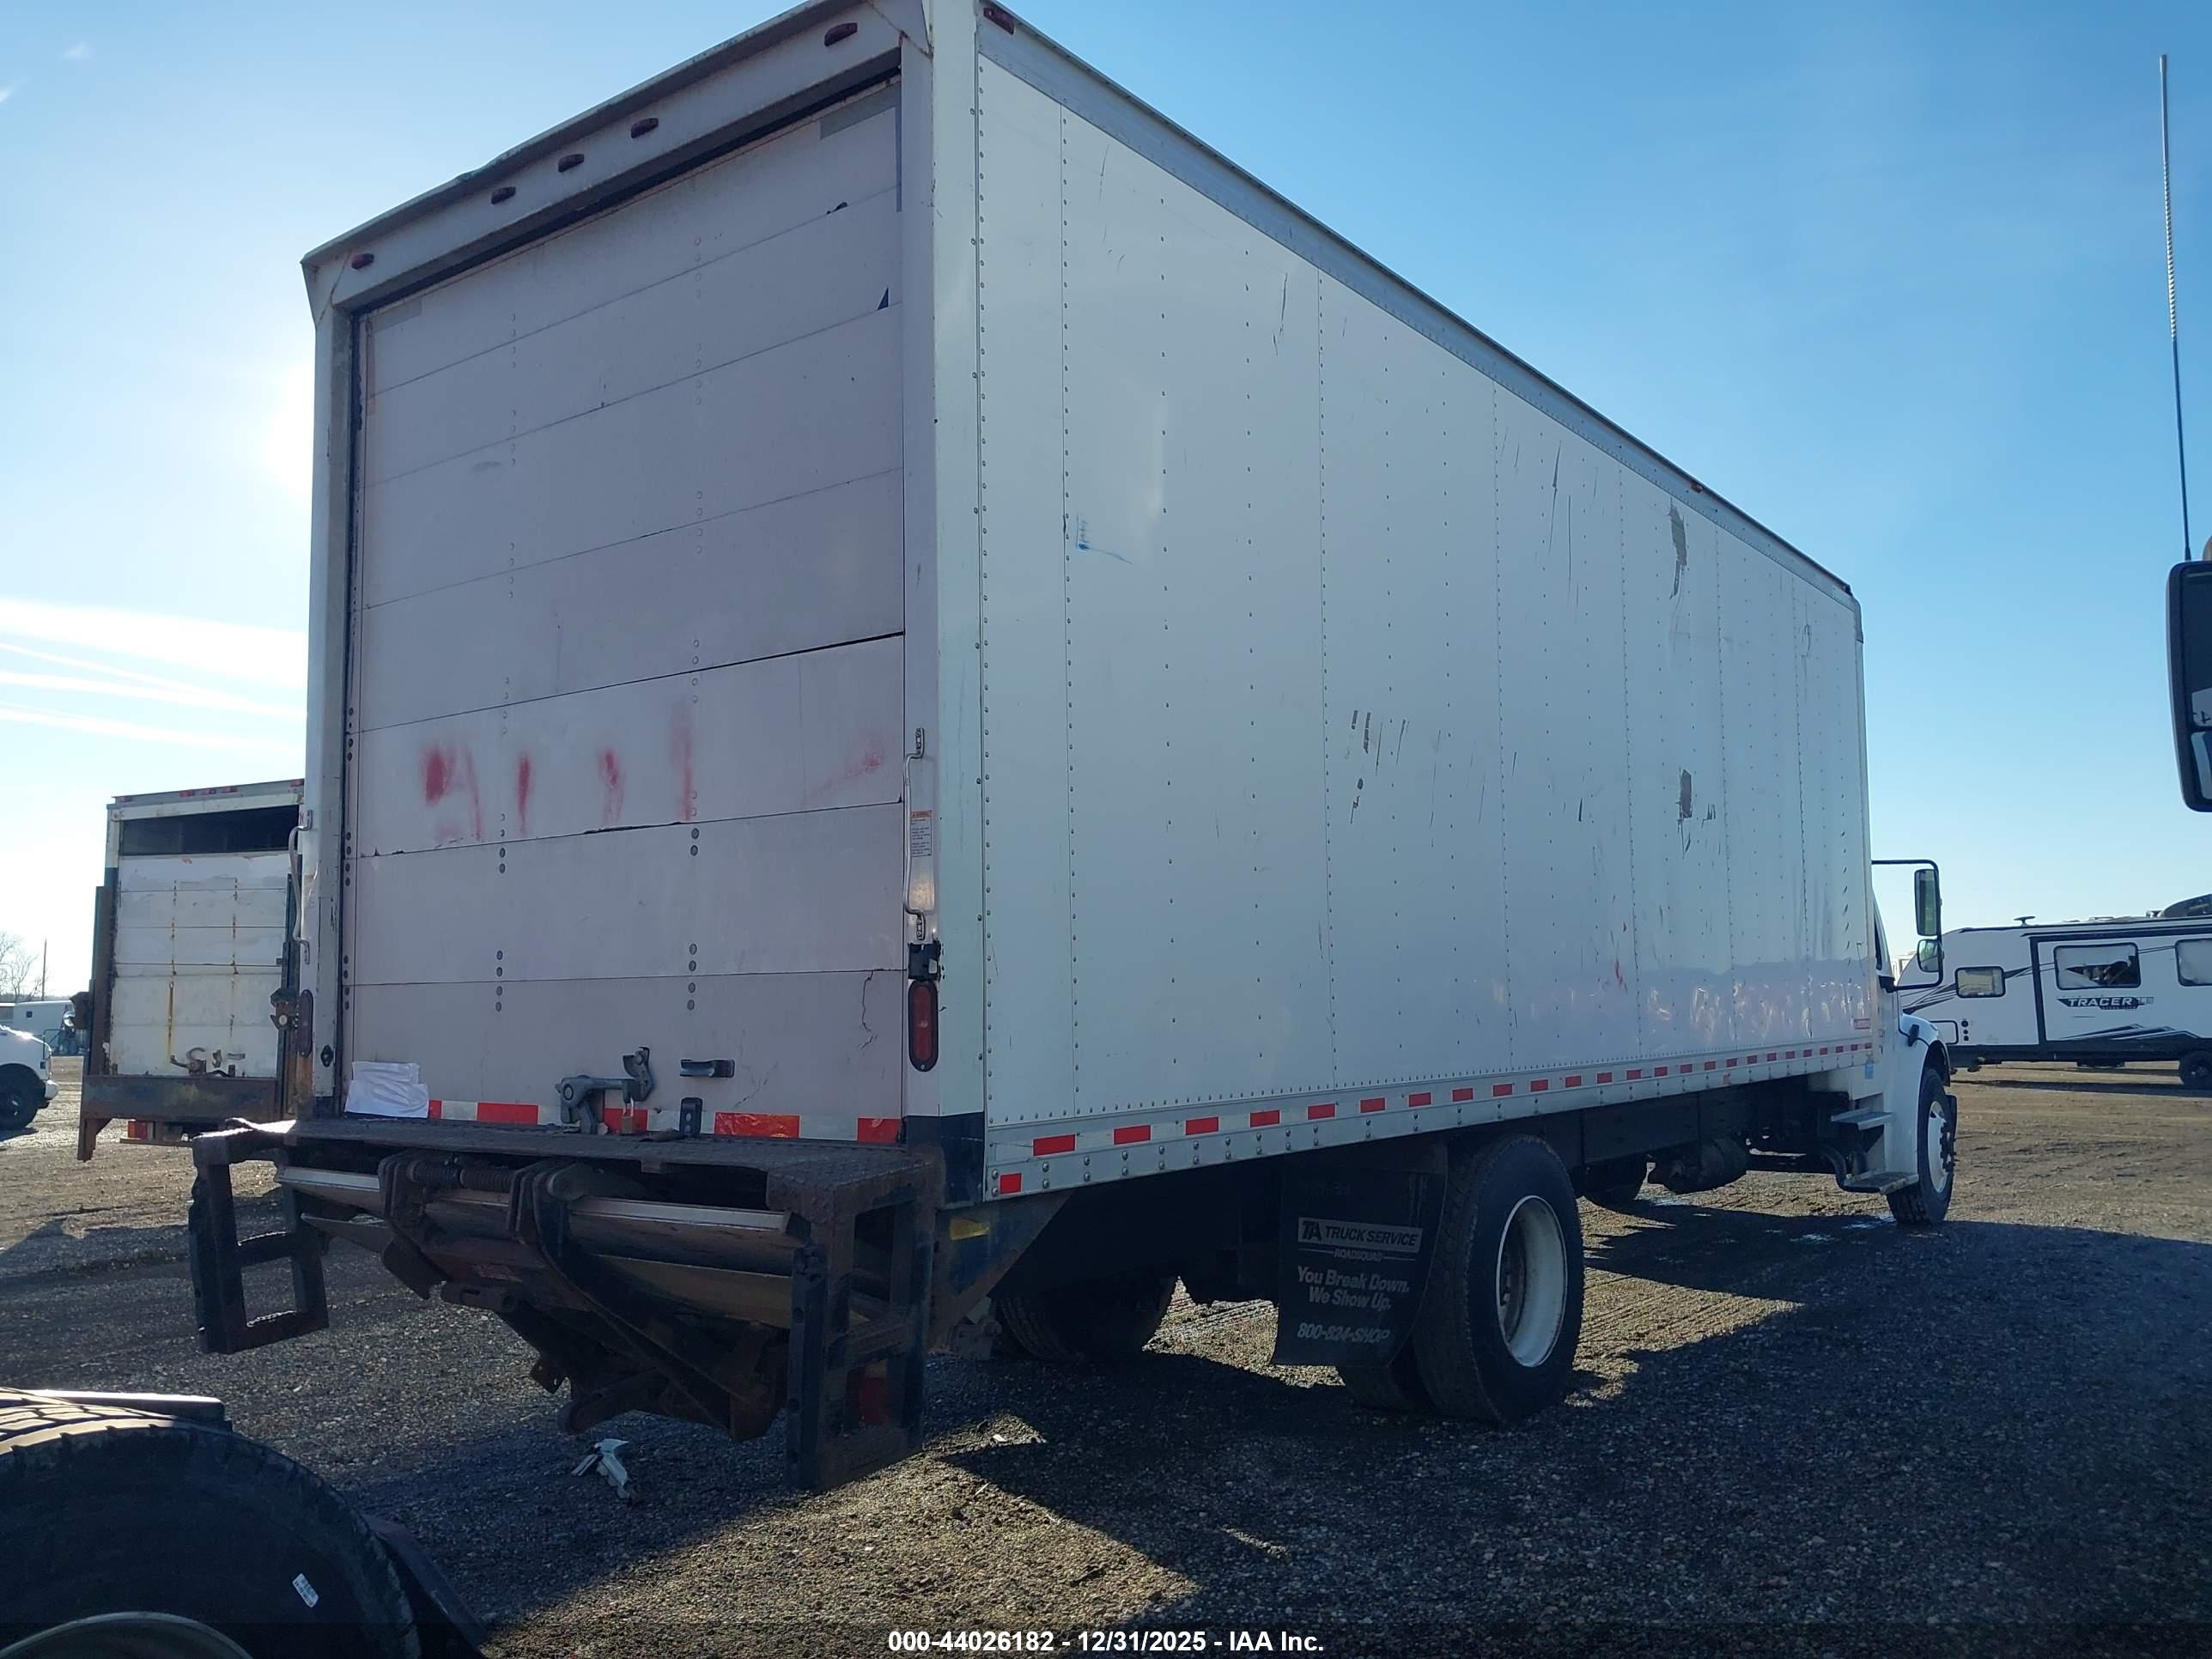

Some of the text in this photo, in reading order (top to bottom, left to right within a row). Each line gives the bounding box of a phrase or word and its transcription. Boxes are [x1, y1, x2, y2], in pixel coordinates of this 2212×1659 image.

[2068, 997, 2132, 1006] TRACER
[1302, 1221, 1418, 1247] TA TRUCK SERVICE
[1297, 1265, 1323, 1284] You
[1325, 1269, 1368, 1289] Break
[1309, 1285, 1331, 1304] We
[1332, 1288, 1371, 1308] Show
